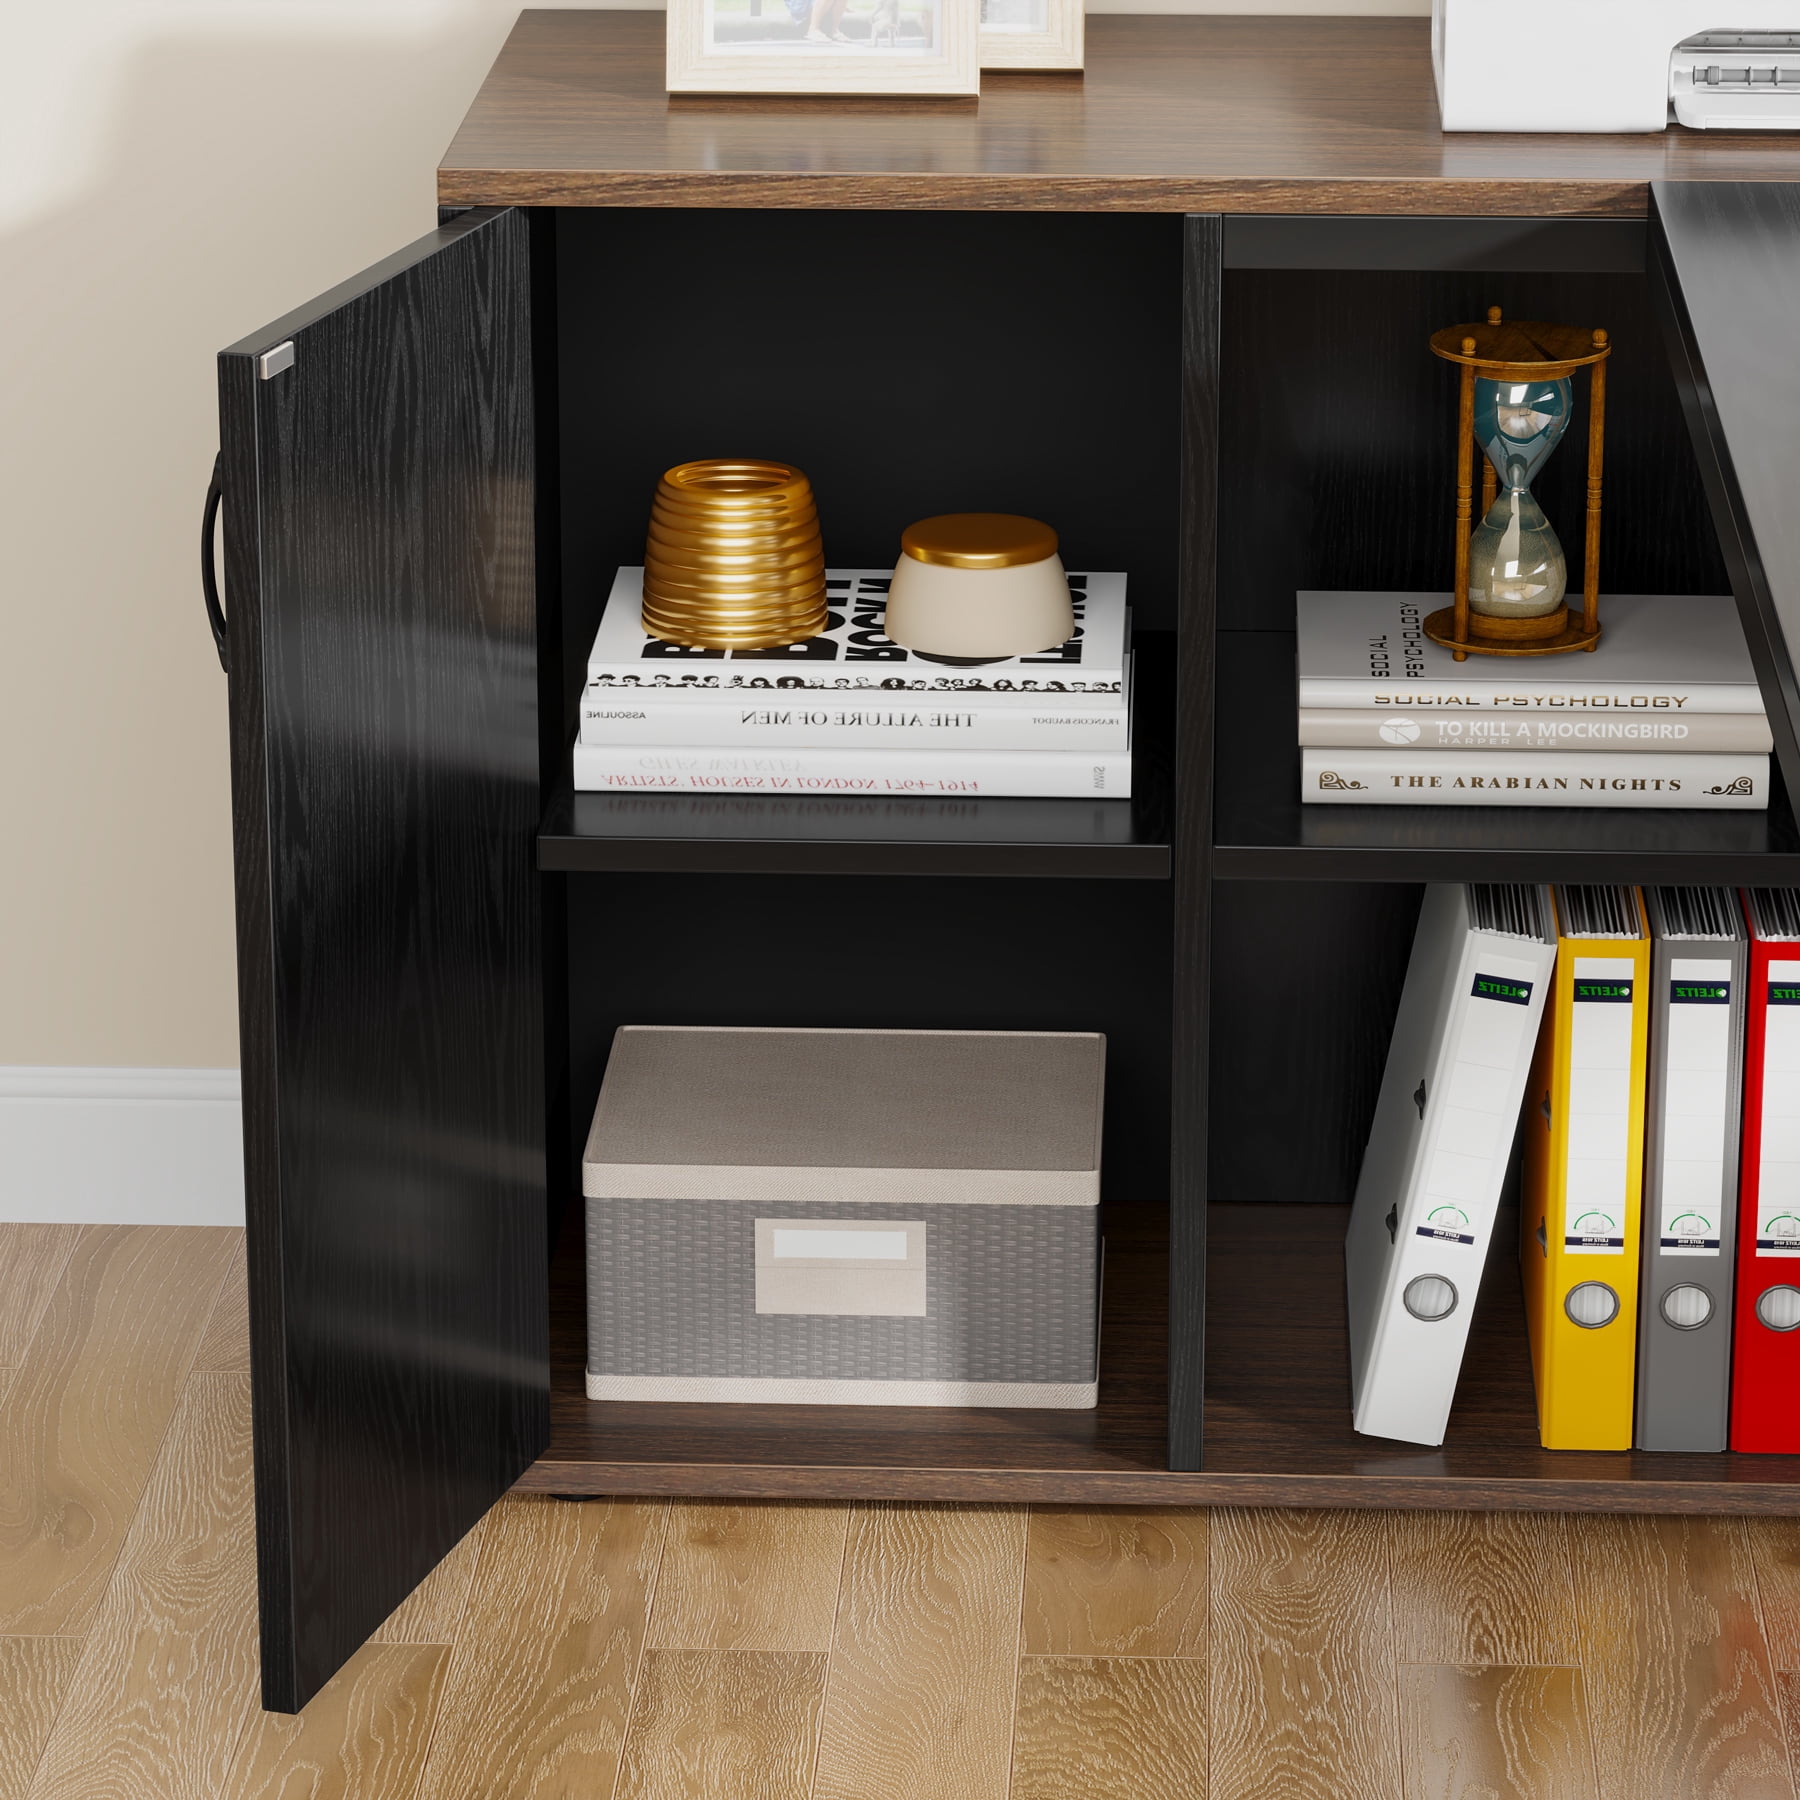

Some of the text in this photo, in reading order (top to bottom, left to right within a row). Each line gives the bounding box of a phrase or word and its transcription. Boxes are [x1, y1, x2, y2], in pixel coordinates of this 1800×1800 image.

[1400, 602, 1424, 677] PSYCHOLOGY
[1369, 635, 1390, 677] SOCIAL
[1374, 694, 1689, 708] SOCIAL PSYCHOLOGY
[1435, 720, 1689, 740] TO KILL A MOCKINGBIRD
[1438, 737, 1557, 746] HARPER LEE
[1390, 775, 1681, 791] THE ARABIAN NIGHTS
